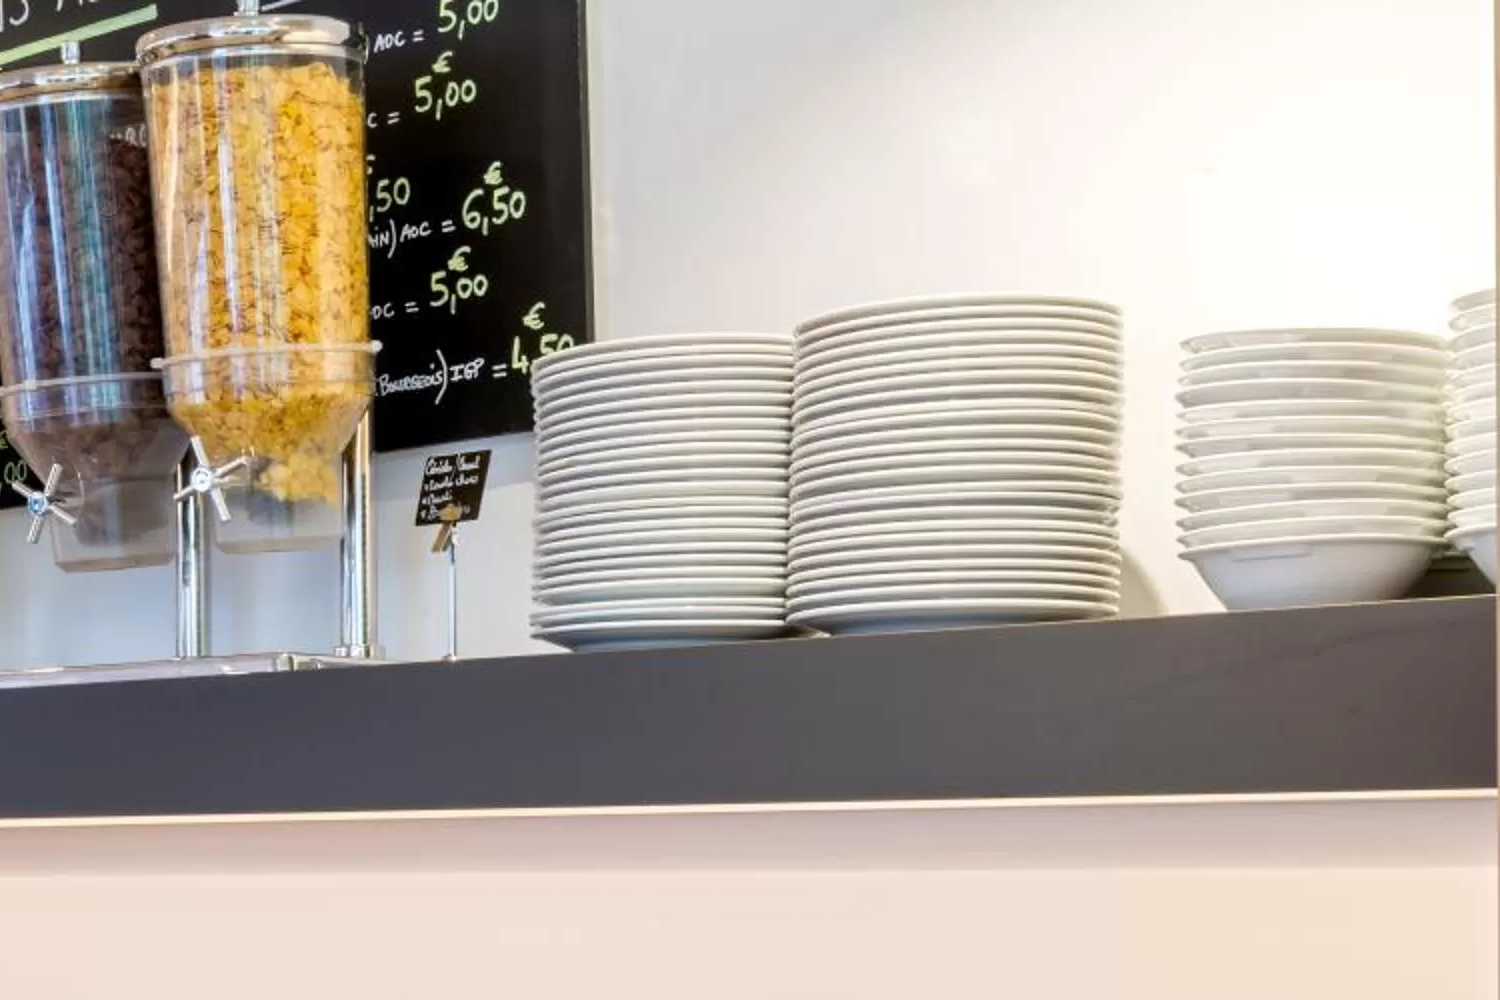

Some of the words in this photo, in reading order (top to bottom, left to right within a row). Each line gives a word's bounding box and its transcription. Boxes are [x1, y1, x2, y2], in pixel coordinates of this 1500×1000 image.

[373, 32, 406, 53] AOC
[437, 0, 499, 41] 5,00
[414, 76, 477, 121] 5,00
[462, 186, 527, 236] 6,50
[430, 271, 488, 315] 5,00
